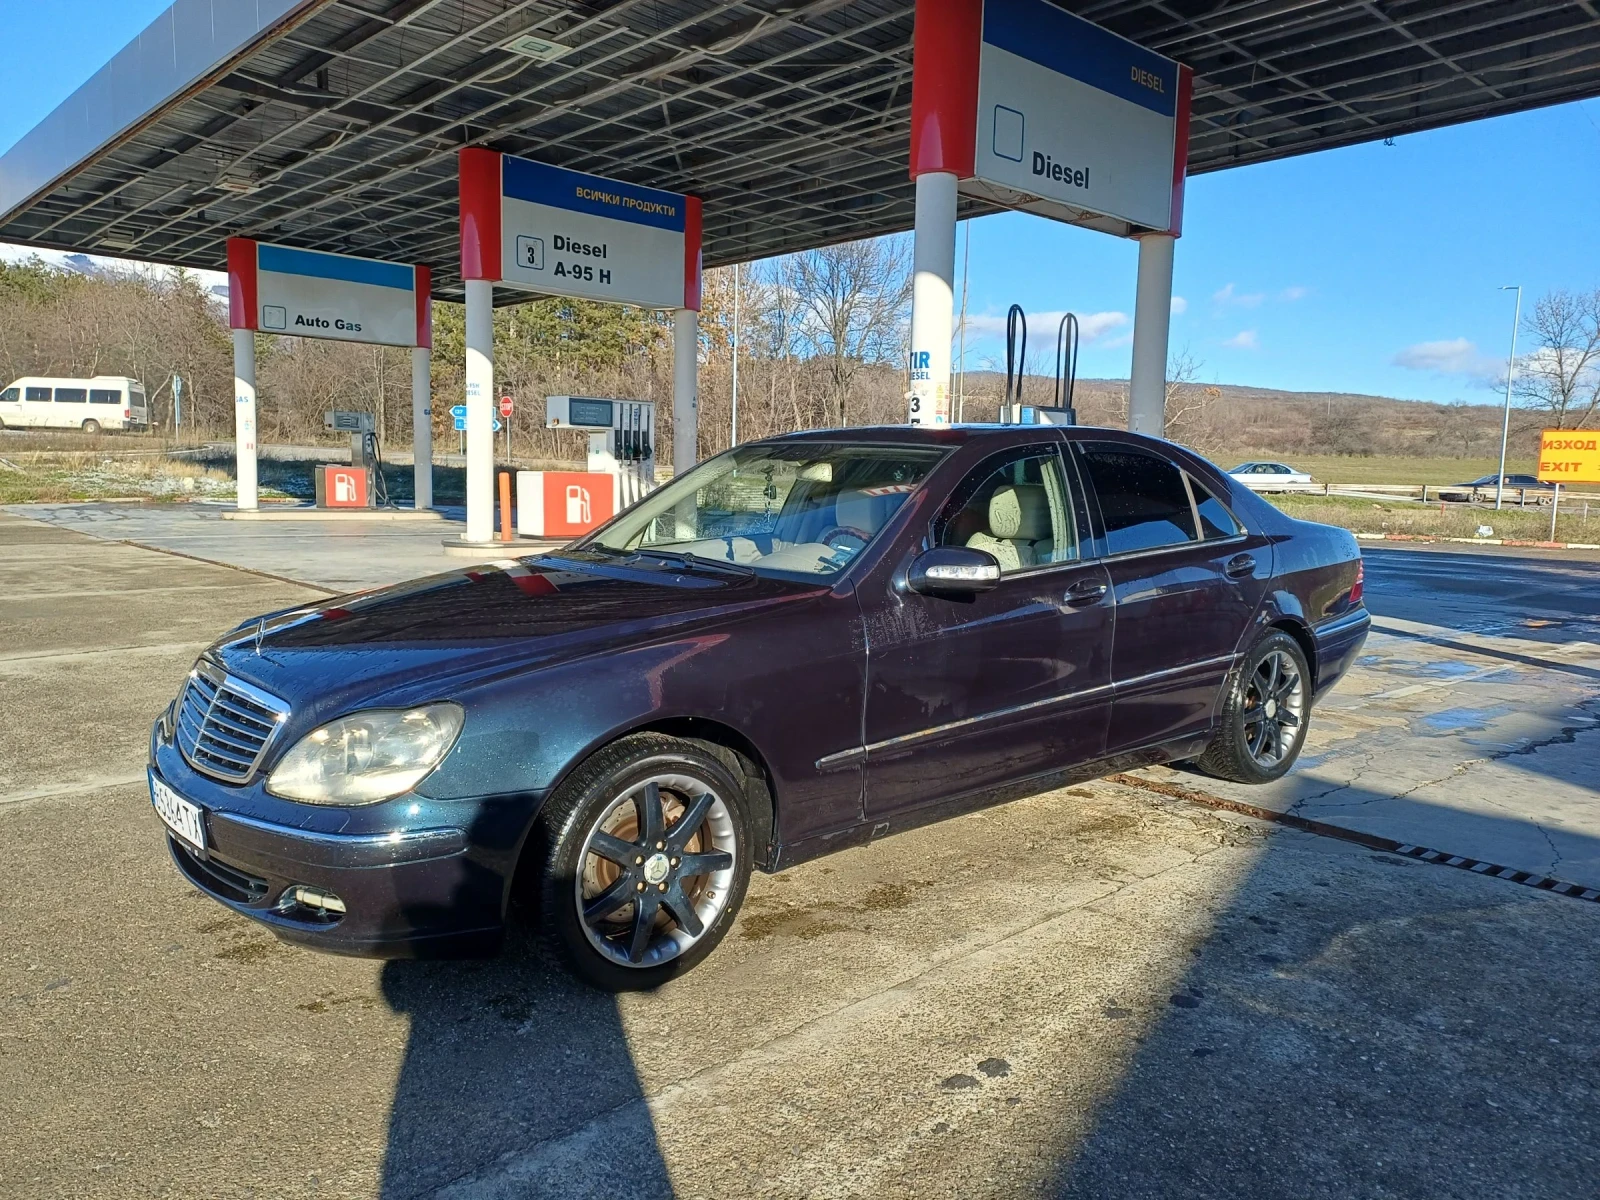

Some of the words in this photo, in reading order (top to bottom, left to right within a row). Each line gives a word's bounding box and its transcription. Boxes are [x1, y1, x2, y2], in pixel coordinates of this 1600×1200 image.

[1131, 66, 1164, 93] DIESEL
[1032, 151, 1089, 189] Diesel
[576, 187, 620, 205] ВСИЧКИ
[622, 197, 675, 217] ПРОДУКТИ
[527, 246, 535, 264] 3
[553, 234, 607, 259] Diesel
[553, 261, 593, 281] A-95
[599, 268, 611, 284] H
[295, 314, 330, 328] Auto
[334, 319, 362, 332] Gas
[911, 397, 920, 413] 3
[1542, 440, 1597, 451] ИЗХОД
[1540, 462, 1583, 472] EXIT
